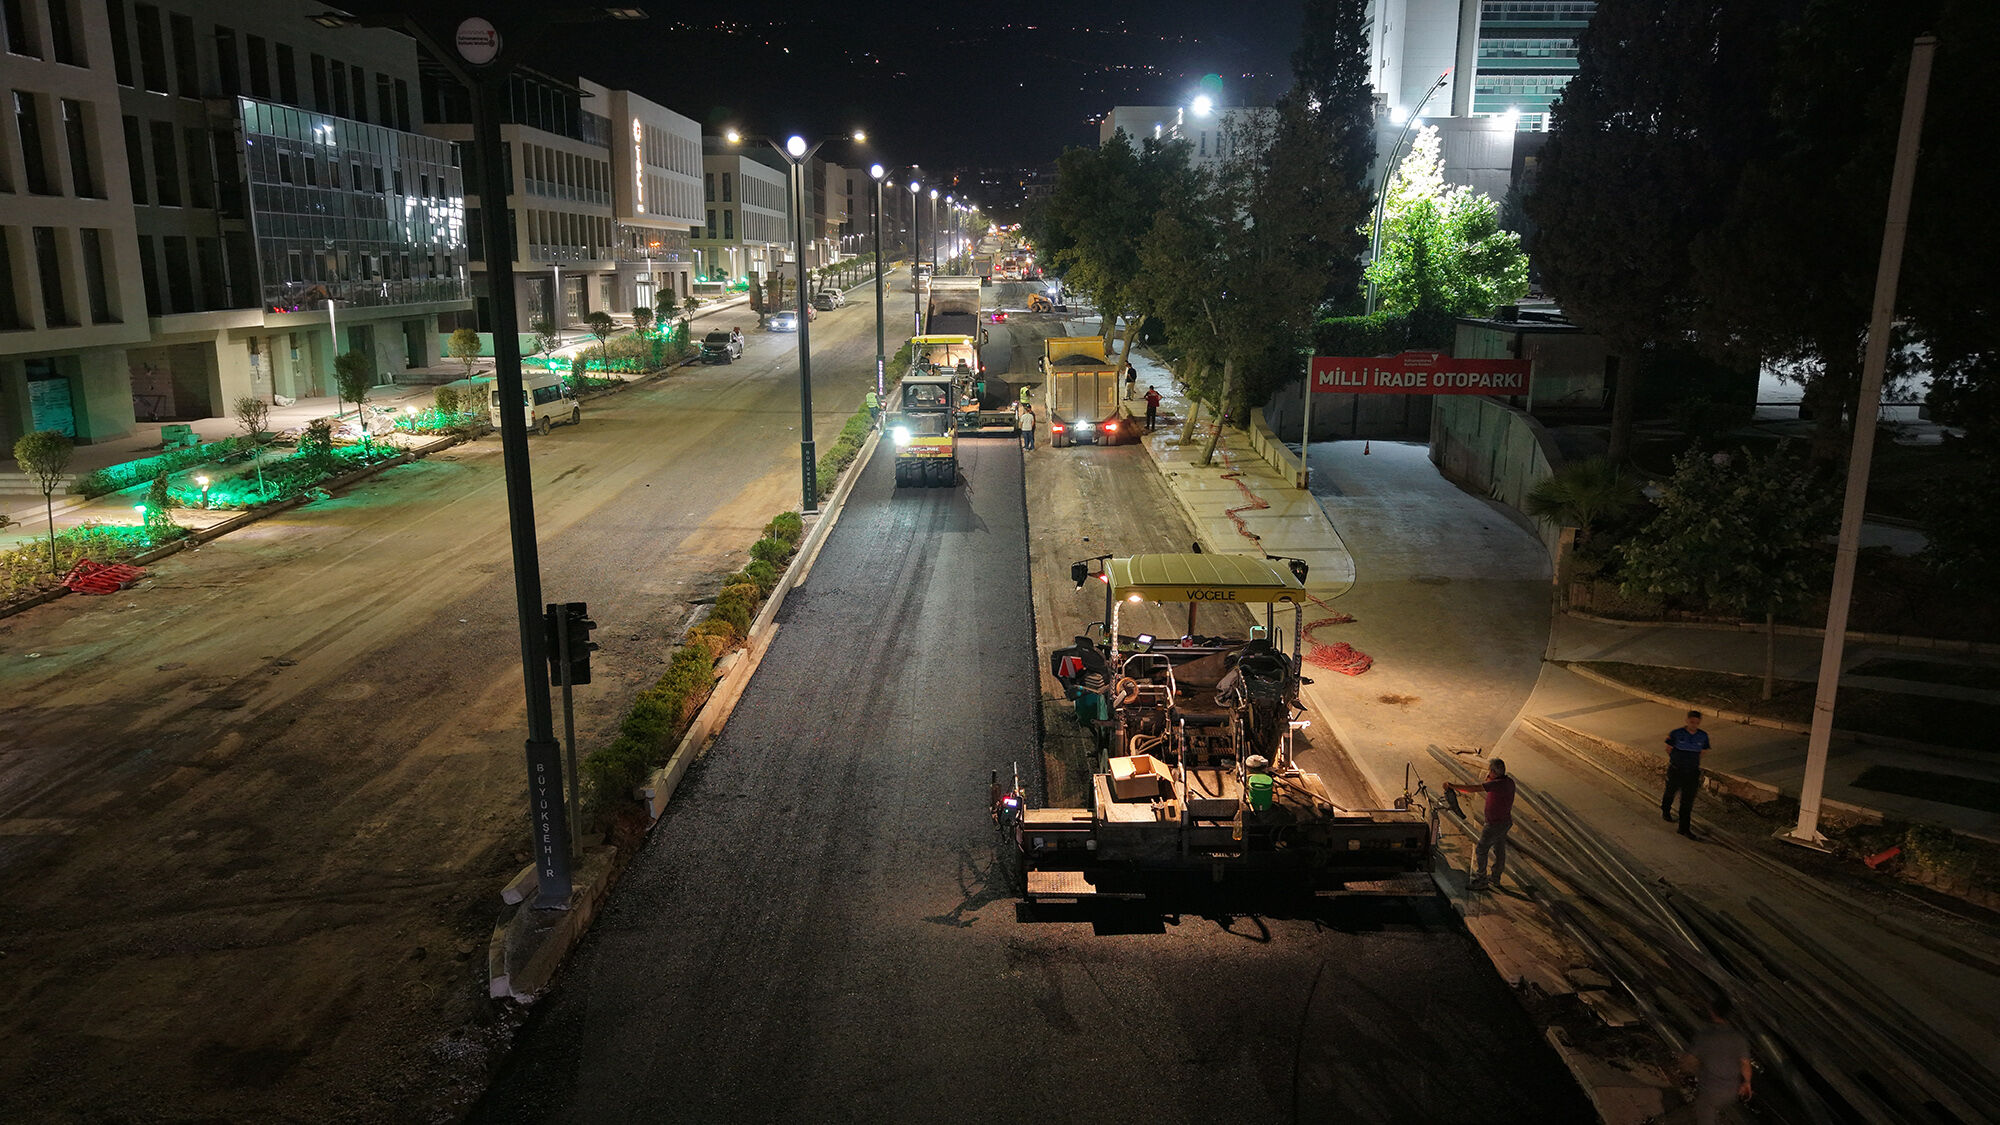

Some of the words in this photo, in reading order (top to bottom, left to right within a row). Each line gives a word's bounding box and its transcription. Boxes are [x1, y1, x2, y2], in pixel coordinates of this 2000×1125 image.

[1319, 368, 1368, 386] MİLLİ
[1374, 369, 1427, 387] İRADE
[1433, 373, 1522, 388] OTOPARKI
